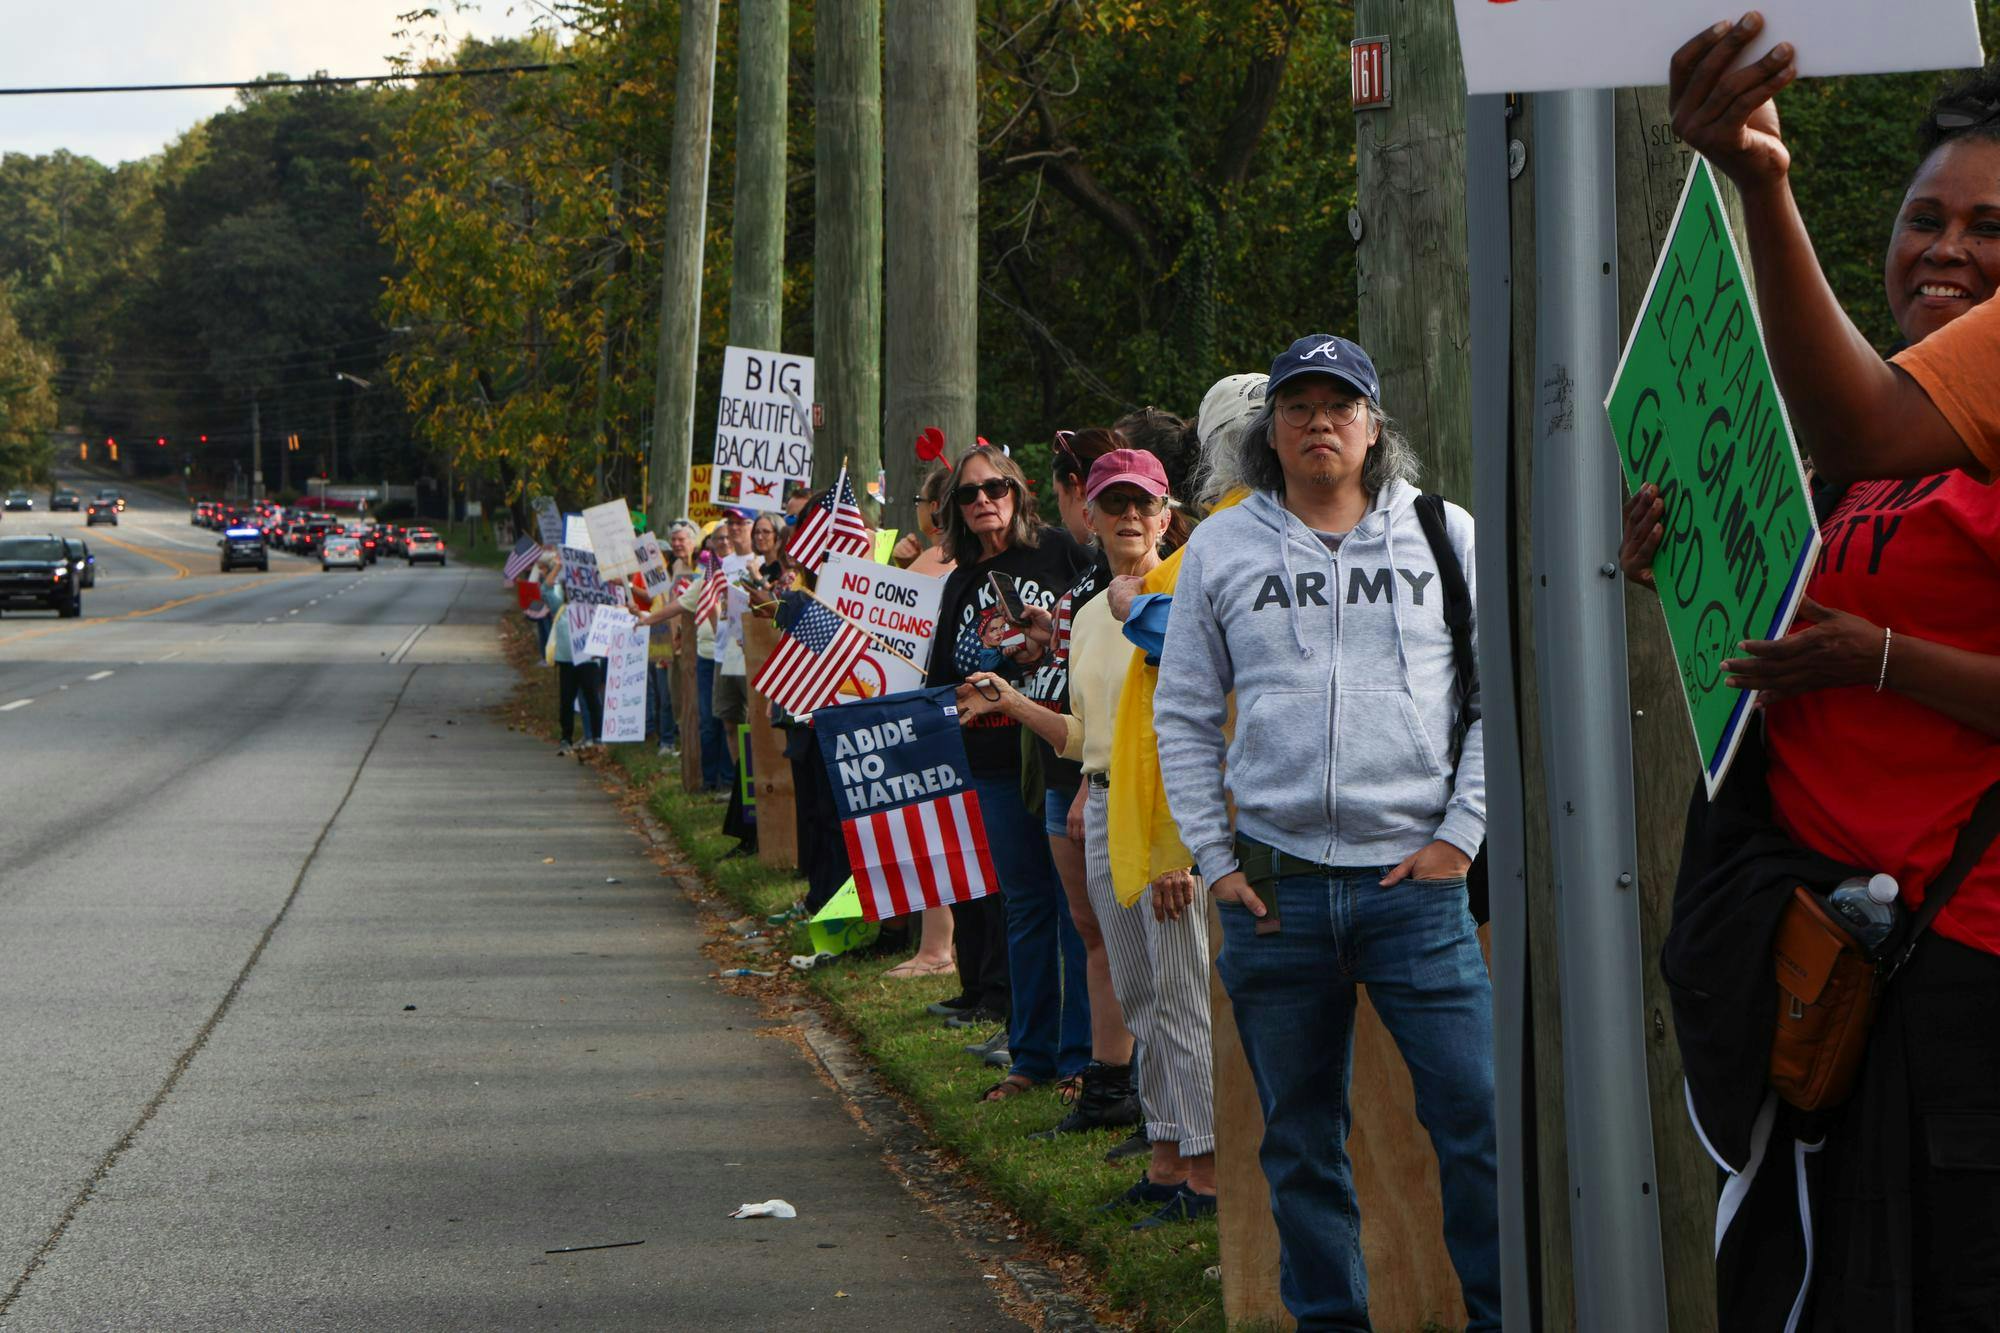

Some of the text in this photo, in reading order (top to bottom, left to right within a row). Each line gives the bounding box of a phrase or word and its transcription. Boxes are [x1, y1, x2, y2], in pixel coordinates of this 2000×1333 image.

[1655, 252, 1705, 404] ICE
[745, 356, 801, 396] BIG
[1688, 202, 1794, 536] TYRANNY
[720, 396, 809, 437] BEAUTIFU
[716, 434, 813, 477] BACKLASH
[841, 571, 919, 608] NO CONS
[1252, 567, 1435, 612] ARMY
[836, 596, 933, 639] NO CLOWNS
[867, 631, 916, 660] INGS
[835, 717, 917, 760] ABIDE
[838, 755, 885, 786] NO
[845, 764, 963, 812] HATRED.
